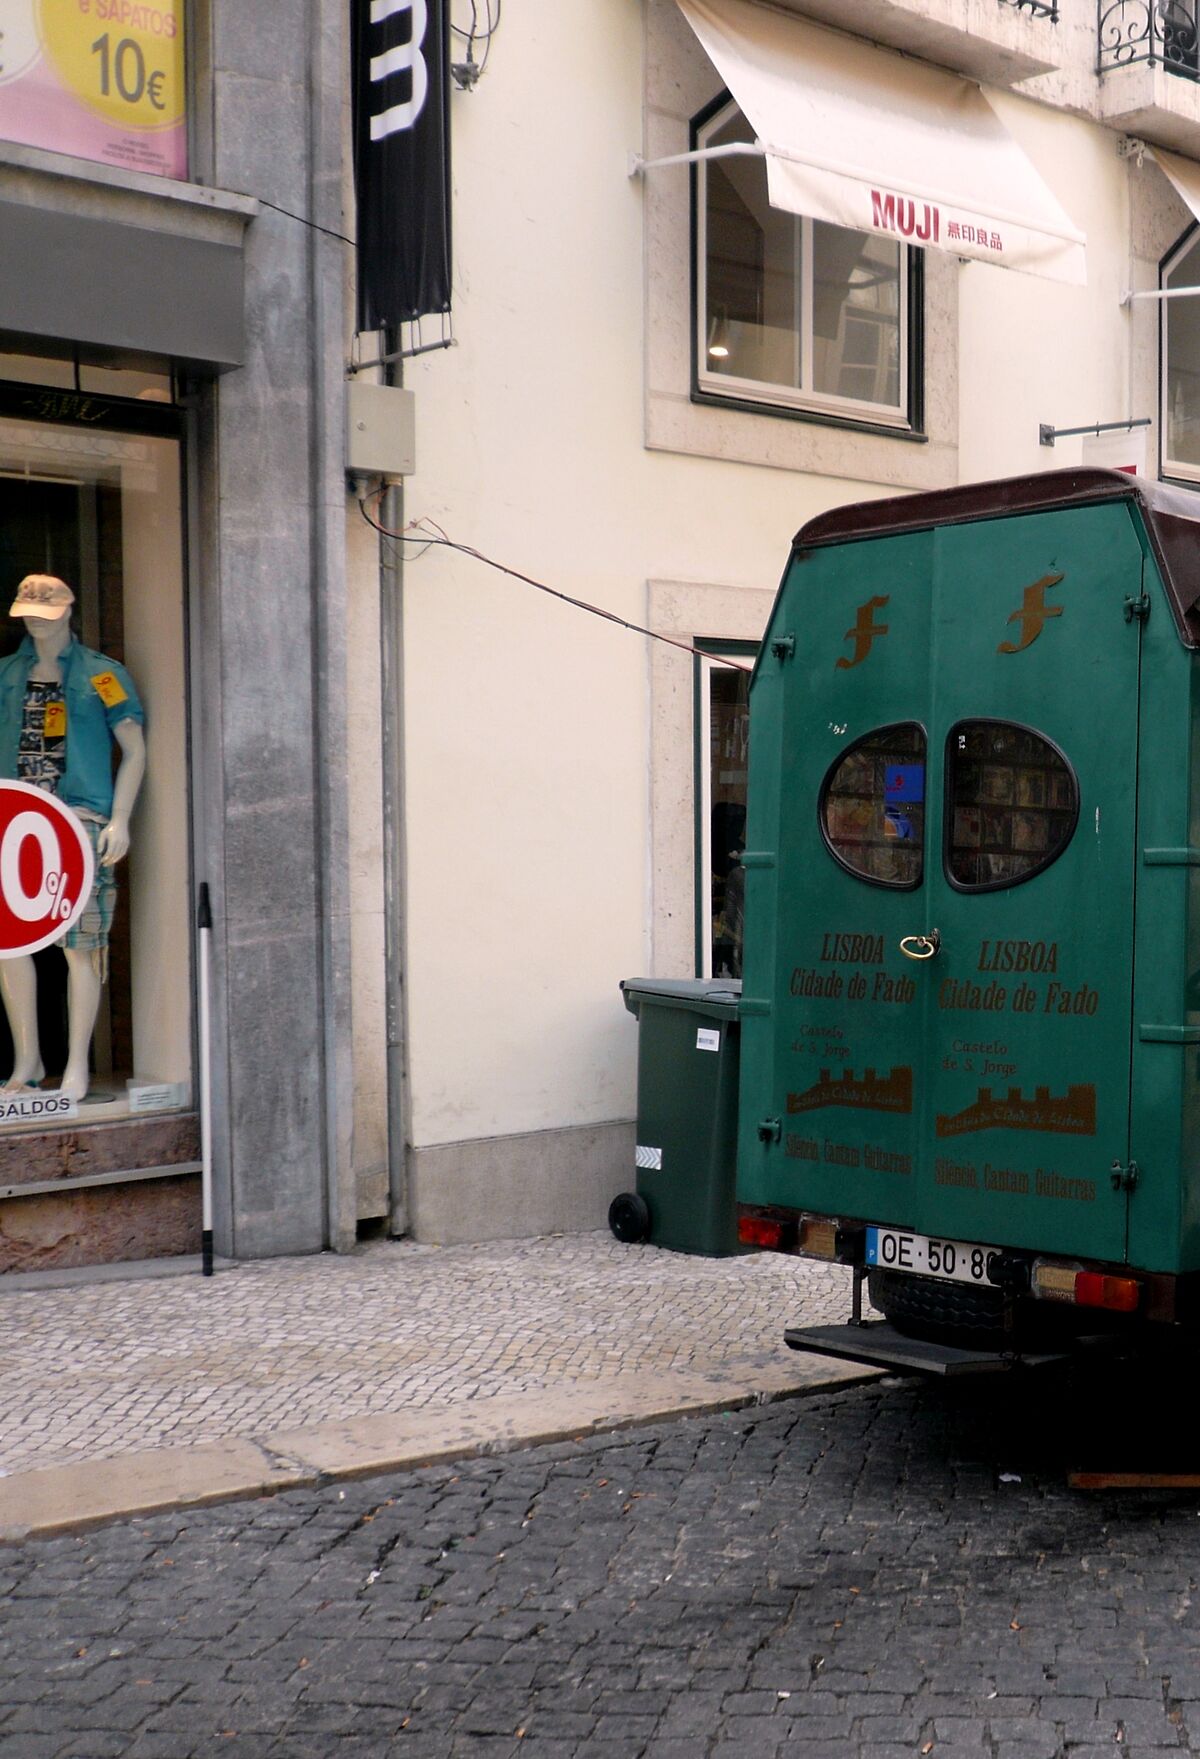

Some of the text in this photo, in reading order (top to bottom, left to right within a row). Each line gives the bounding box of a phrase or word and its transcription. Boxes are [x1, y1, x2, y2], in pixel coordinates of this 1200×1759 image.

[96, 0, 177, 38] SAPATOS
[92, 32, 166, 110] 10€
[871, 189, 1003, 251] MUJI 無印良品
[820, 932, 885, 964] LISBOA
[977, 940, 1058, 974] LISBOA
[790, 967, 916, 1004] Cidade de Fado
[938, 977, 1099, 1017] Cidade de Fado
[952, 1039, 1008, 1055] Castelo
[942, 1055, 958, 1071] de
[980, 1059, 1017, 1079] Jorge
[1035, 1167, 1097, 1202] Guitarras
[869, 1249, 875, 1258] P
